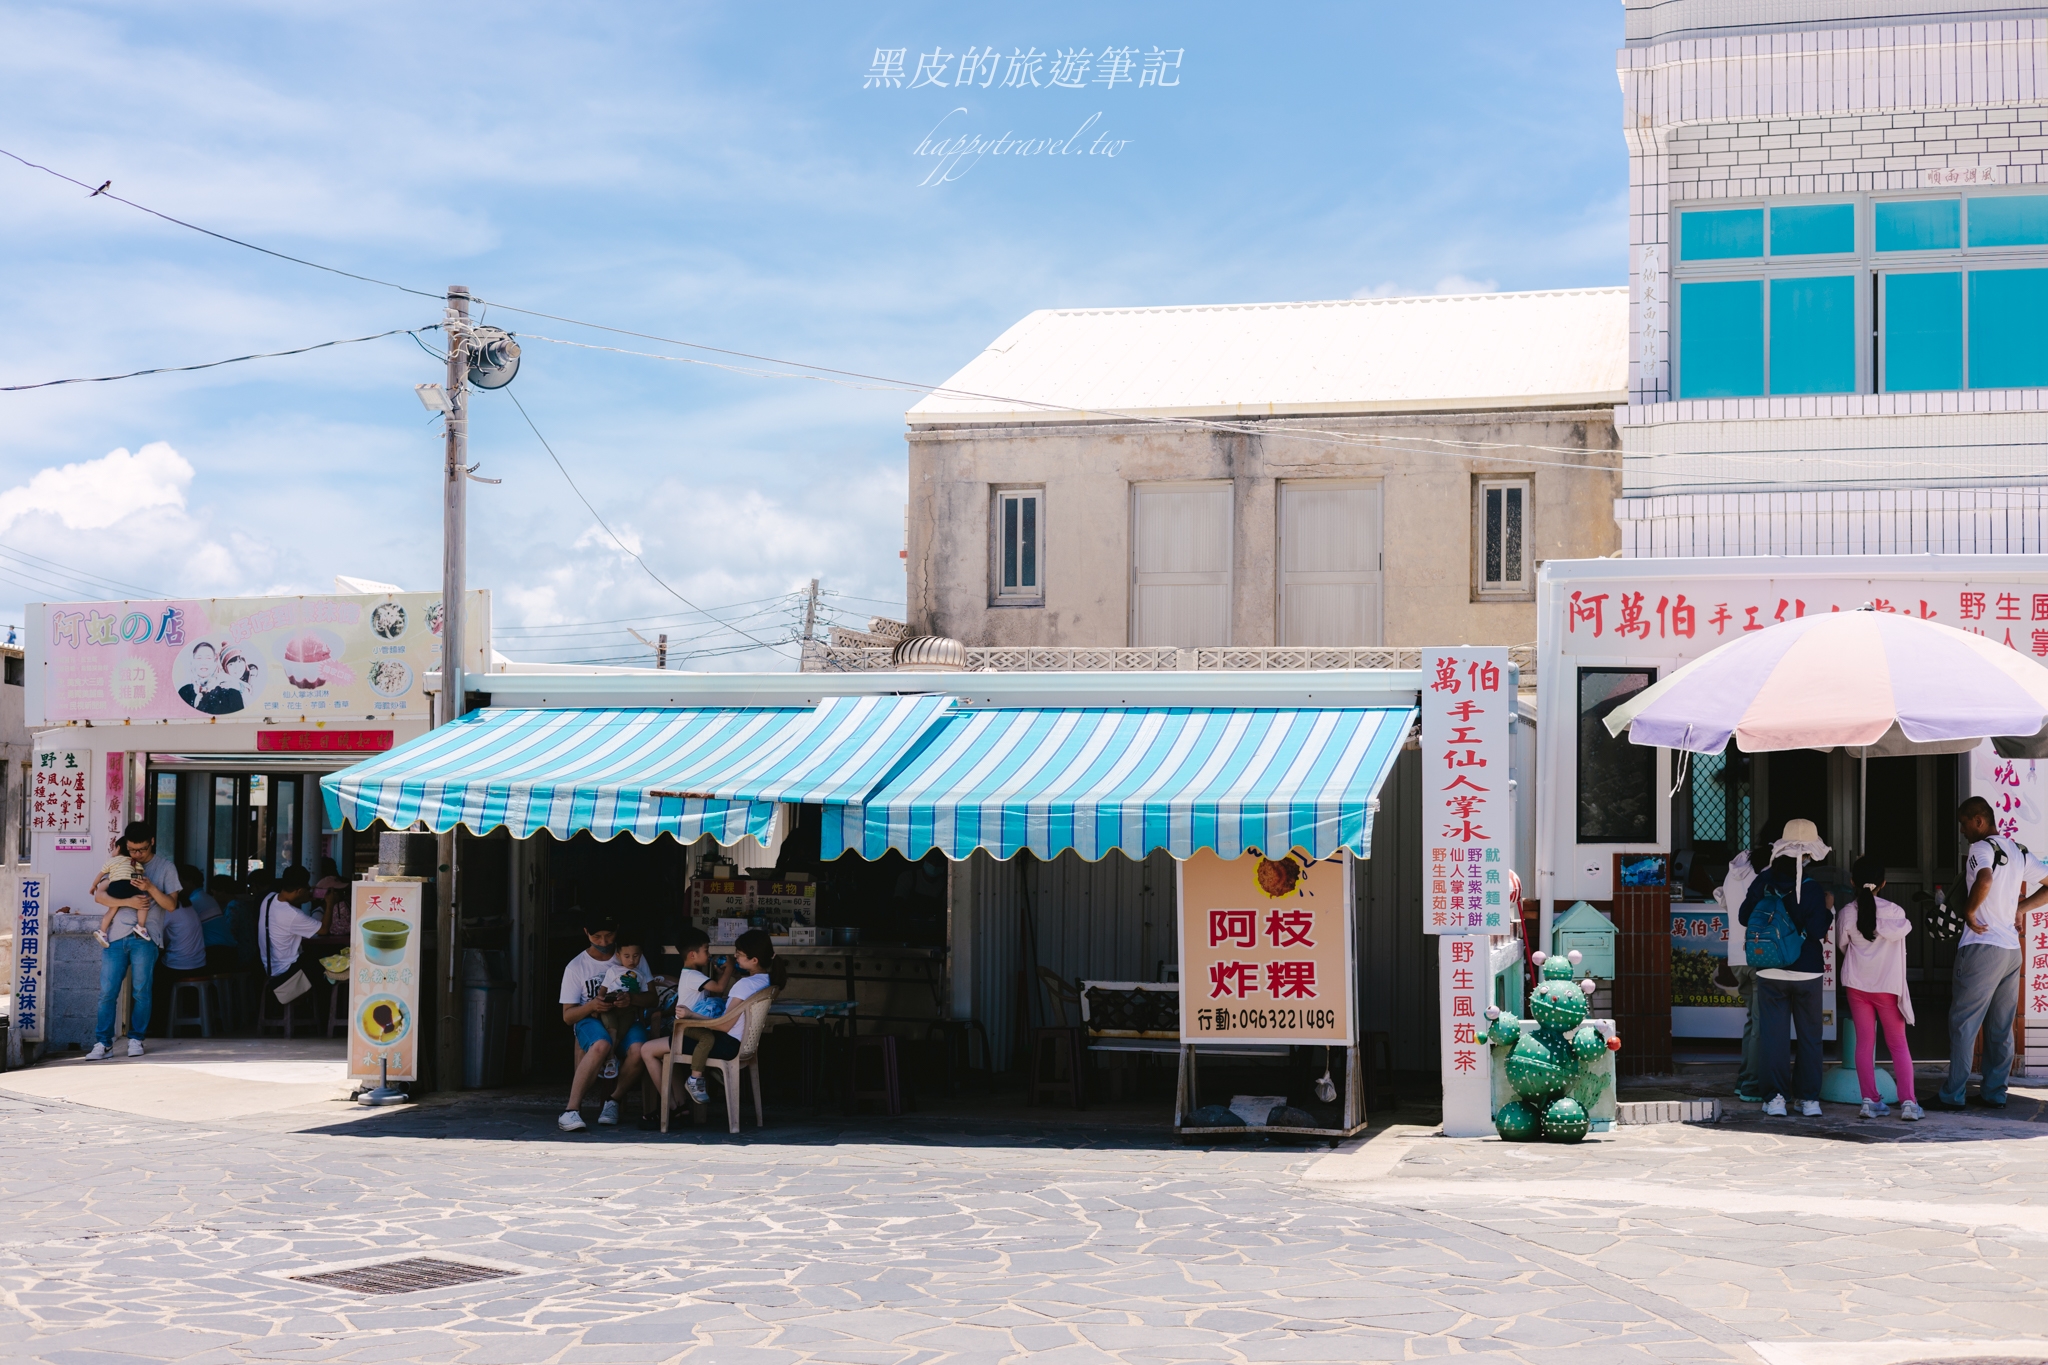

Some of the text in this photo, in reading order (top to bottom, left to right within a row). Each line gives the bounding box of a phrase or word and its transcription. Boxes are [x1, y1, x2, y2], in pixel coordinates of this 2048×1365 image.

[53, 606, 185, 649] 阿虹の店
[119, 667, 146, 681] 強力
[119, 685, 146, 699] 推薦
[1430, 656, 1500, 694] 萬伯
[41, 752, 78, 769] 野生
[1440, 699, 1491, 843] 手工仙人掌冰
[33, 771, 46, 829] 各種飲料
[46, 773, 59, 827] 風茹茶
[60, 775, 73, 830] 仙人掌汁
[73, 772, 86, 826] 蘆薈汁
[368, 895, 406, 913] 天然
[771, 882, 797, 895] 炸物
[1432, 847, 1447, 927] 野生風茹茶
[1450, 847, 1465, 927] 仙人掌果汁
[1467, 847, 1483, 927] 野生紫菜餅
[1485, 847, 1501, 927] 魷魚麵線
[18, 880, 40, 1030] 花粉採用宇治抹茶
[1208, 909, 1316, 949] 阿枝
[1208, 960, 1318, 1000] 炸粿
[1452, 941, 1477, 1072] 野生風茹茶
[1198, 1008, 1334, 1031] 行動:0963221489
